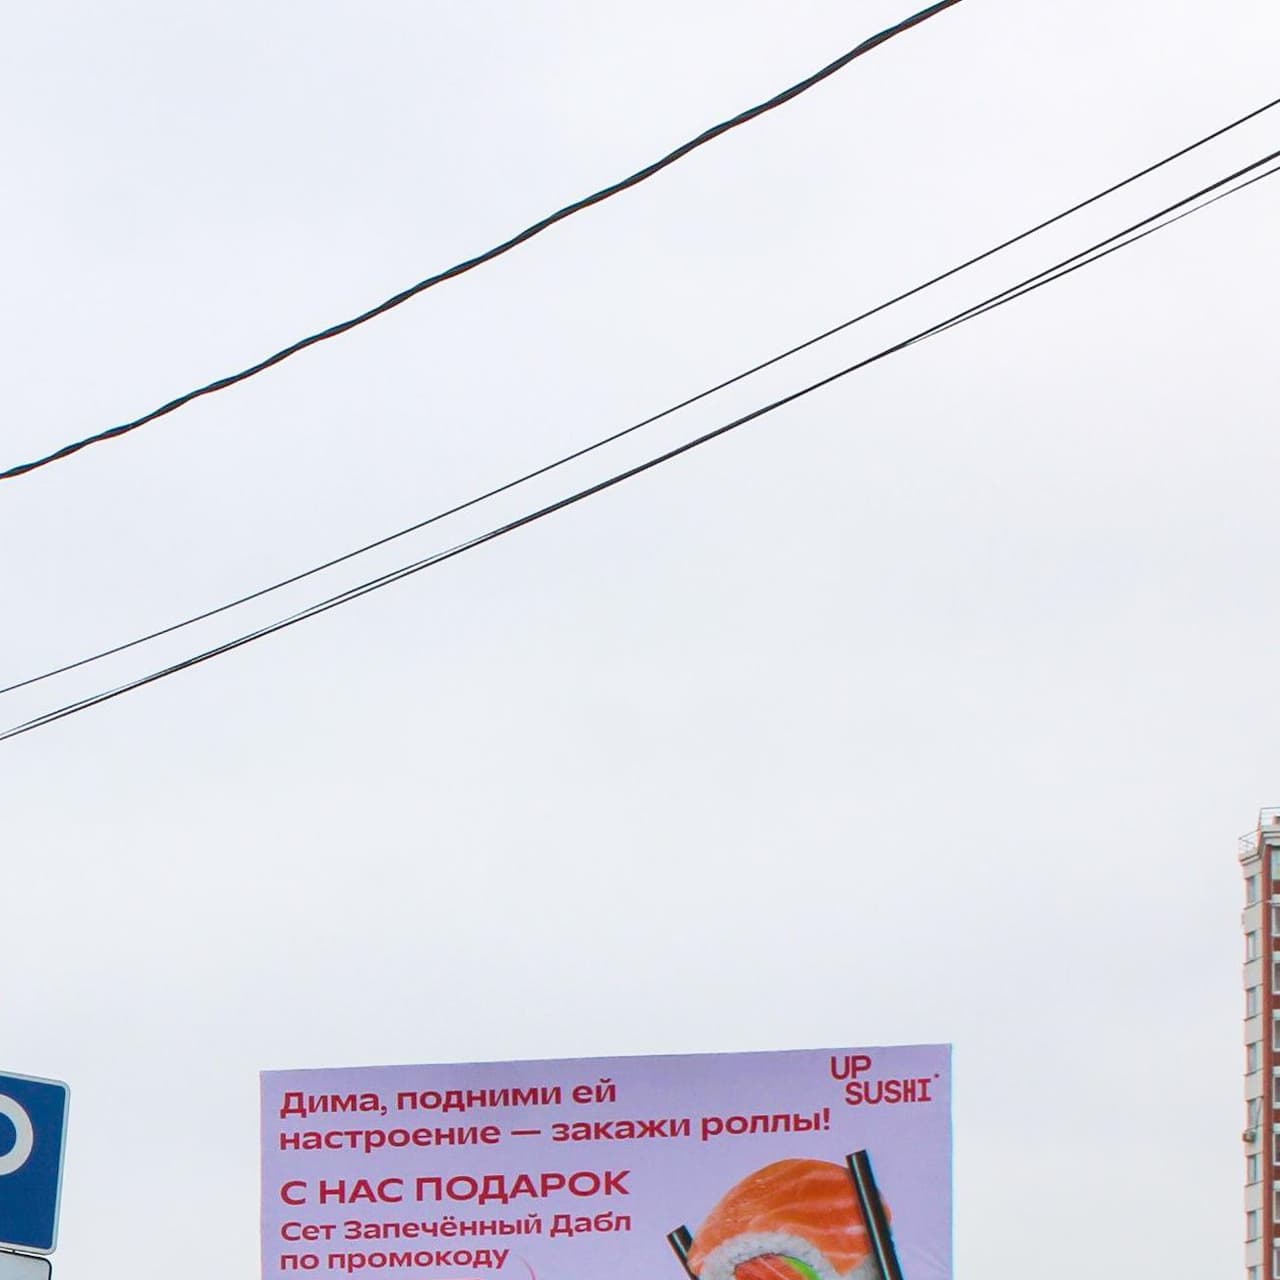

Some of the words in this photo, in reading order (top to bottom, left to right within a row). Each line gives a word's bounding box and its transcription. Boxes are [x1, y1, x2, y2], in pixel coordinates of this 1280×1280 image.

[830, 1054, 873, 1080] UP
[279, 1091, 388, 1119] Дима,
[397, 1086, 562, 1112] подними
[571, 1077, 617, 1105] ей
[844, 1078, 932, 1106] SUSHI
[280, 1125, 501, 1154] настроение
[551, 1118, 691, 1142] закажи
[701, 1107, 831, 1142] роллы!
[280, 1180, 307, 1206] С
[319, 1177, 404, 1205] НАС
[416, 1170, 631, 1205] ПОДАРОК
[280, 1221, 337, 1242] Сет
[343, 1213, 542, 1241] Запечённый
[549, 1210, 632, 1238] Дабл
[280, 1254, 320, 1271] по
[328, 1248, 510, 1274] промокоду
